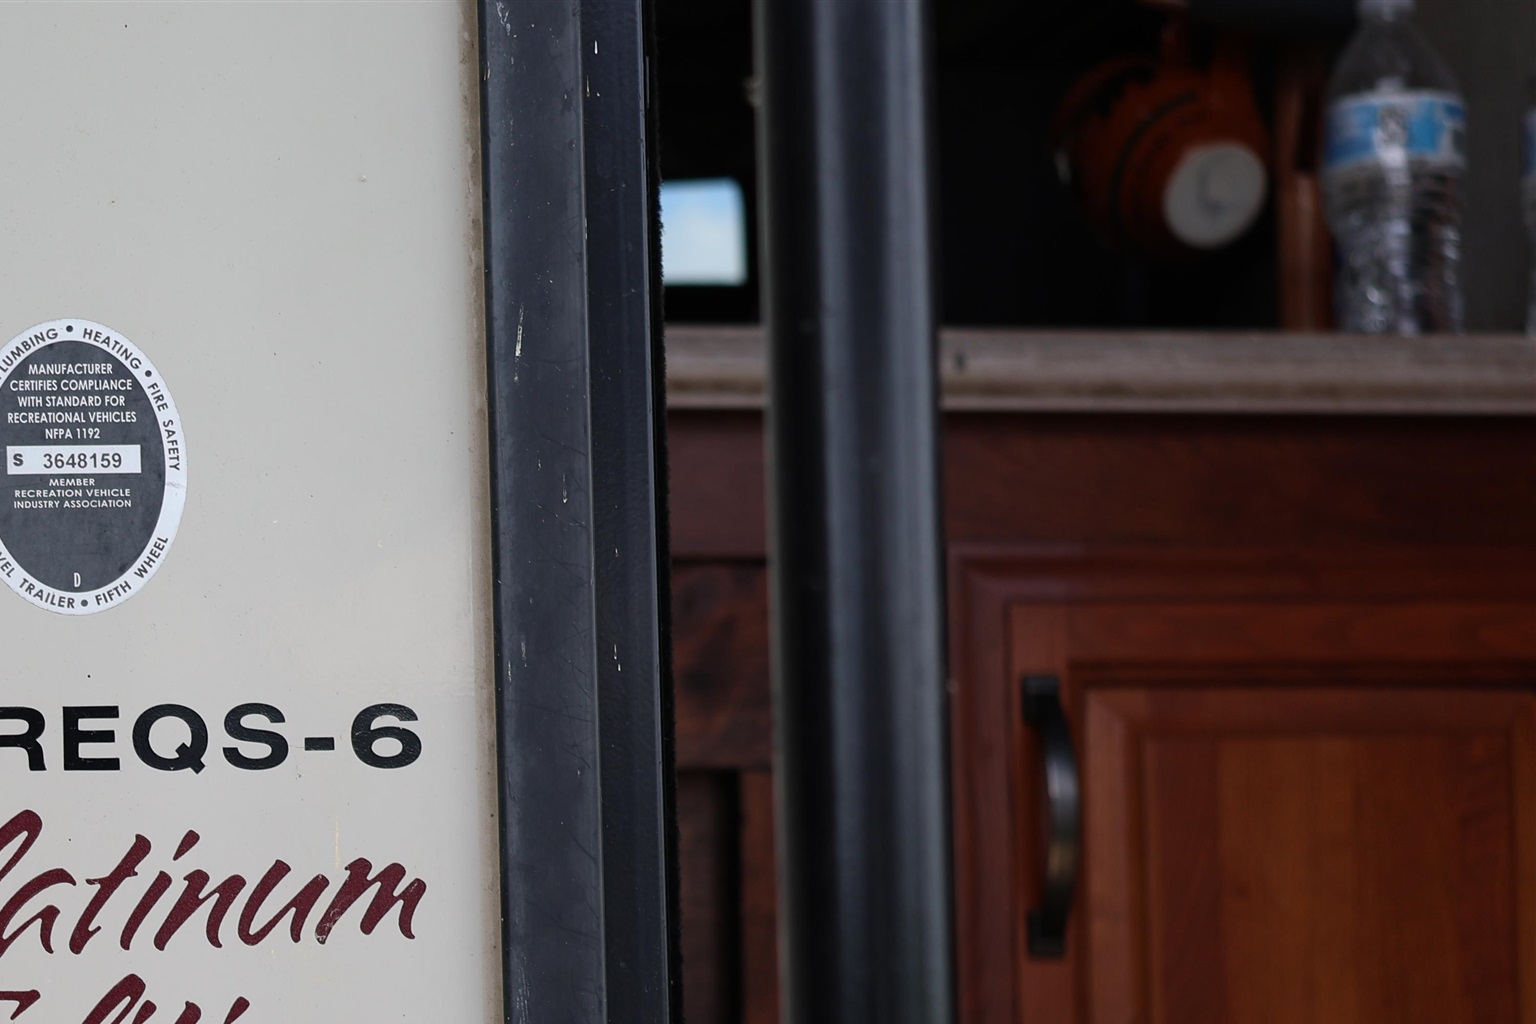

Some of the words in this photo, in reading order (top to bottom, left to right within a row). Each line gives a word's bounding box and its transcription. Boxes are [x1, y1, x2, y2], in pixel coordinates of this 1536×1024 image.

[28, 364, 113, 375] MANUFACTURER
[10, 380, 57, 391] CERTIFIES
[61, 379, 132, 390] COMPLIANCE
[17, 396, 42, 407] WITH
[45, 396, 102, 407] STANDARD
[105, 396, 125, 406] FOR
[83, 328, 142, 370] HEATING
[147, 383, 168, 412] FIRE
[163, 420, 180, 471] SAFETY
[8, 412, 86, 423] RECREATIONAL
[88, 412, 136, 422] VEHICLES
[45, 429, 72, 439] NFPA
[76, 428, 100, 439] 1192
[13, 454, 23, 466] S
[43, 453, 122, 468] 3648159
[49, 478, 95, 486] MEMBER
[15, 489, 83, 497] RECREATION
[86, 489, 130, 497] VEHICLE
[63, 500, 131, 508] ASSOCIATION
[19, 578, 75, 609] TRAILER
[95, 581, 131, 605] FIFTH
[134, 536, 168, 578] WHEEL
[74, 573, 81, 587] D
